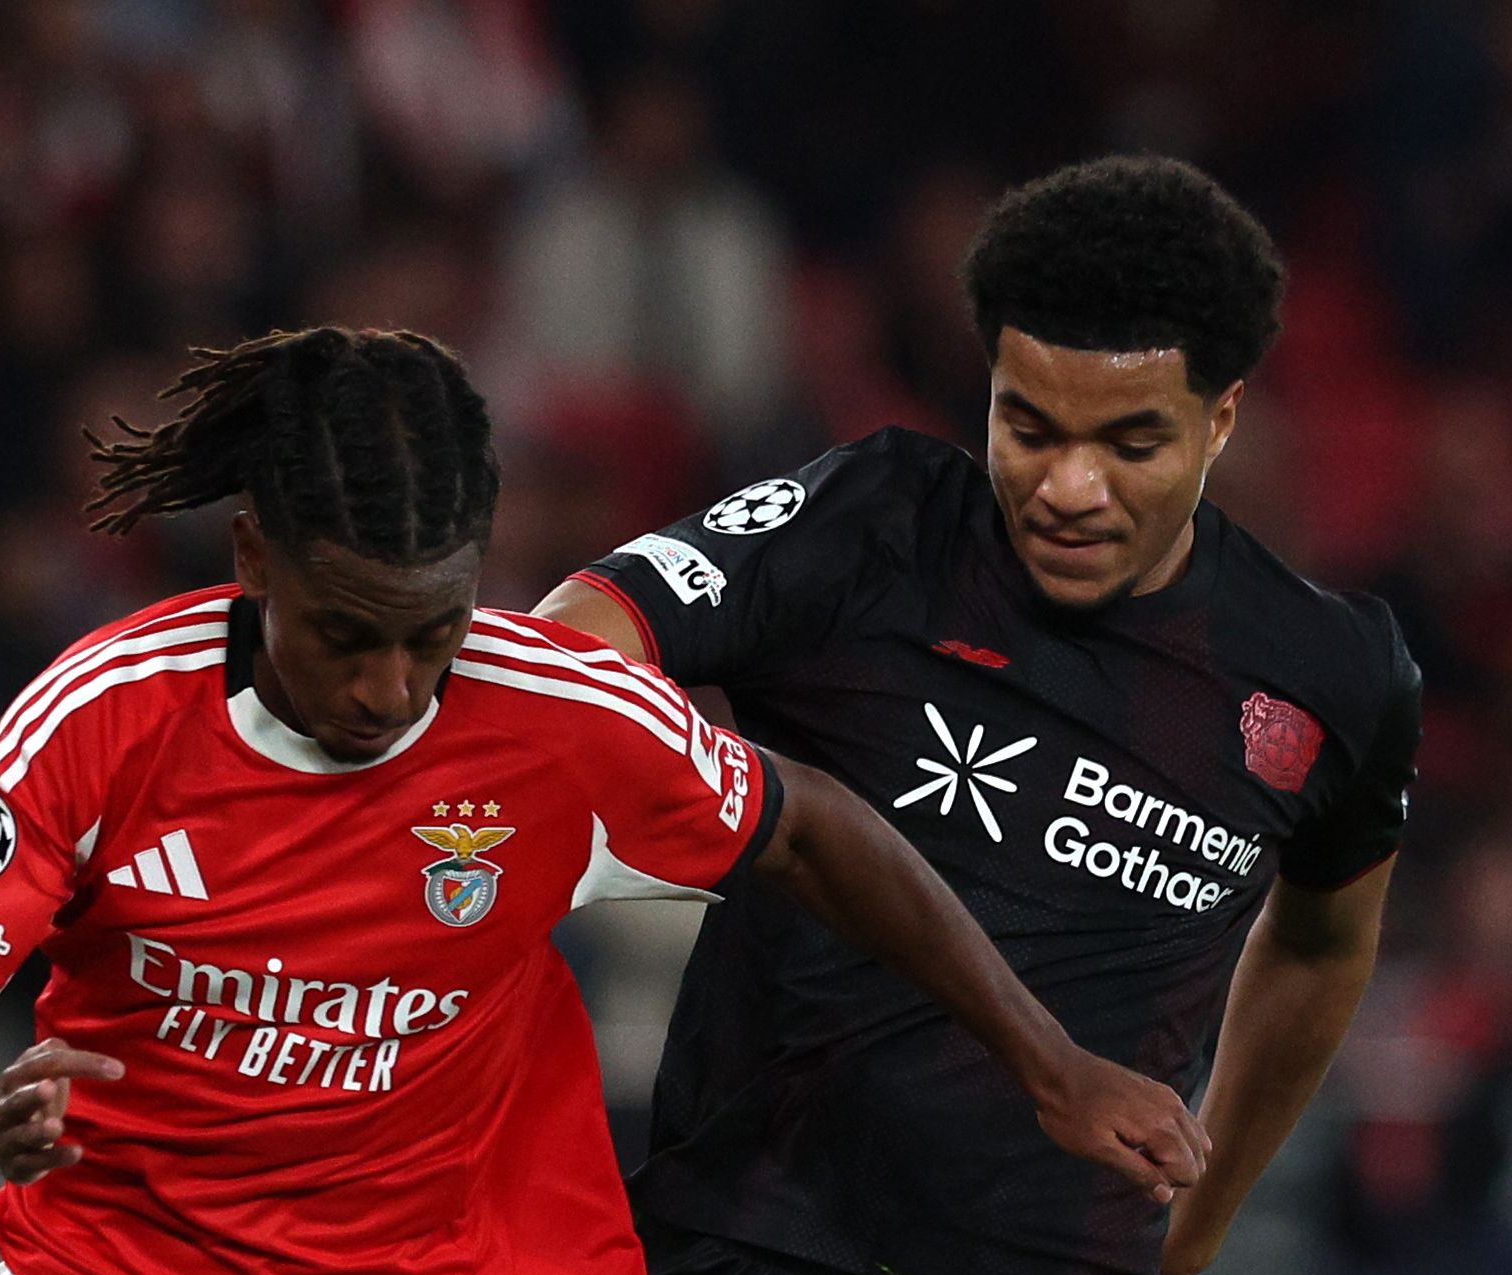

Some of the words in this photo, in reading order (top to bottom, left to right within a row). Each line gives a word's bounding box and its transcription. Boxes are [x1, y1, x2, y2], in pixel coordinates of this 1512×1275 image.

[1044, 816, 1234, 913] Gothaer
[1063, 756, 1263, 877] Barmenia
[125, 932, 470, 1039] Emirates
[157, 1004, 238, 1061] FLY
[238, 1026, 401, 1092] BETTER
